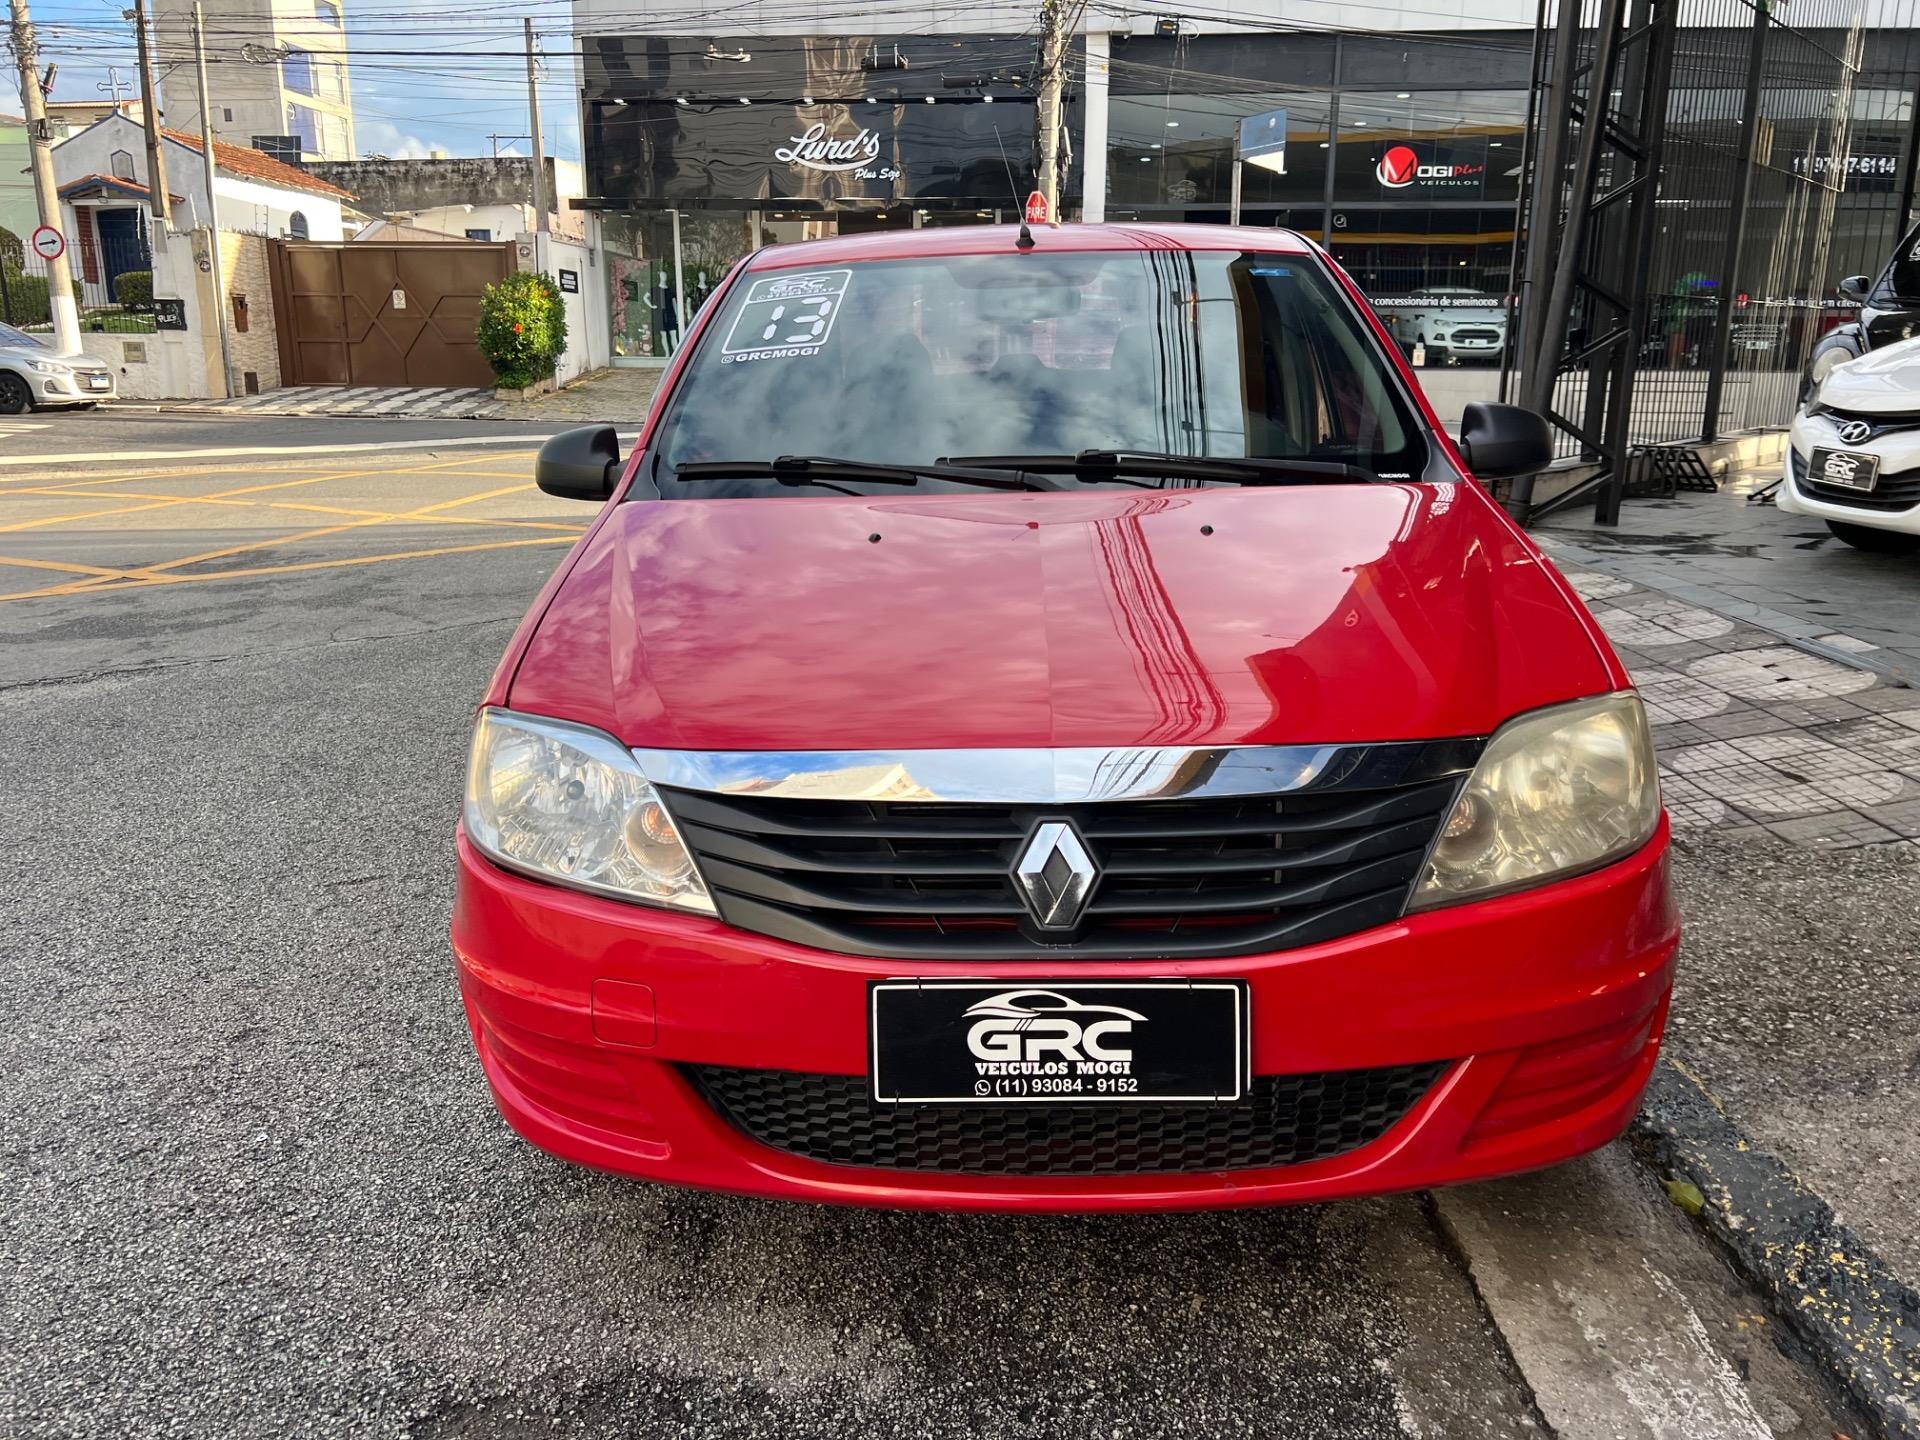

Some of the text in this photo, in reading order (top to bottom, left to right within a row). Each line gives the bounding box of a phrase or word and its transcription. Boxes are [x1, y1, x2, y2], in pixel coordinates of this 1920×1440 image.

[1814, 157, 1896, 173] 977-6114
[855, 169, 876, 180] Plus
[1027, 206, 1046, 219] PARE
[1375, 297, 1437, 306] concessionária
[1440, 296, 1450, 306] de
[762, 296, 833, 343] 13
[735, 346, 820, 362] GRCMOGI
[1824, 459, 1857, 476] GRC
[967, 1018, 1133, 1062] GRC
[974, 1062, 1131, 1075] VEICULOS MOGI
[995, 1078, 1028, 1096] (11)
[1032, 1078, 1083, 1093] 93084
[1096, 1078, 1138, 1093] 9152
